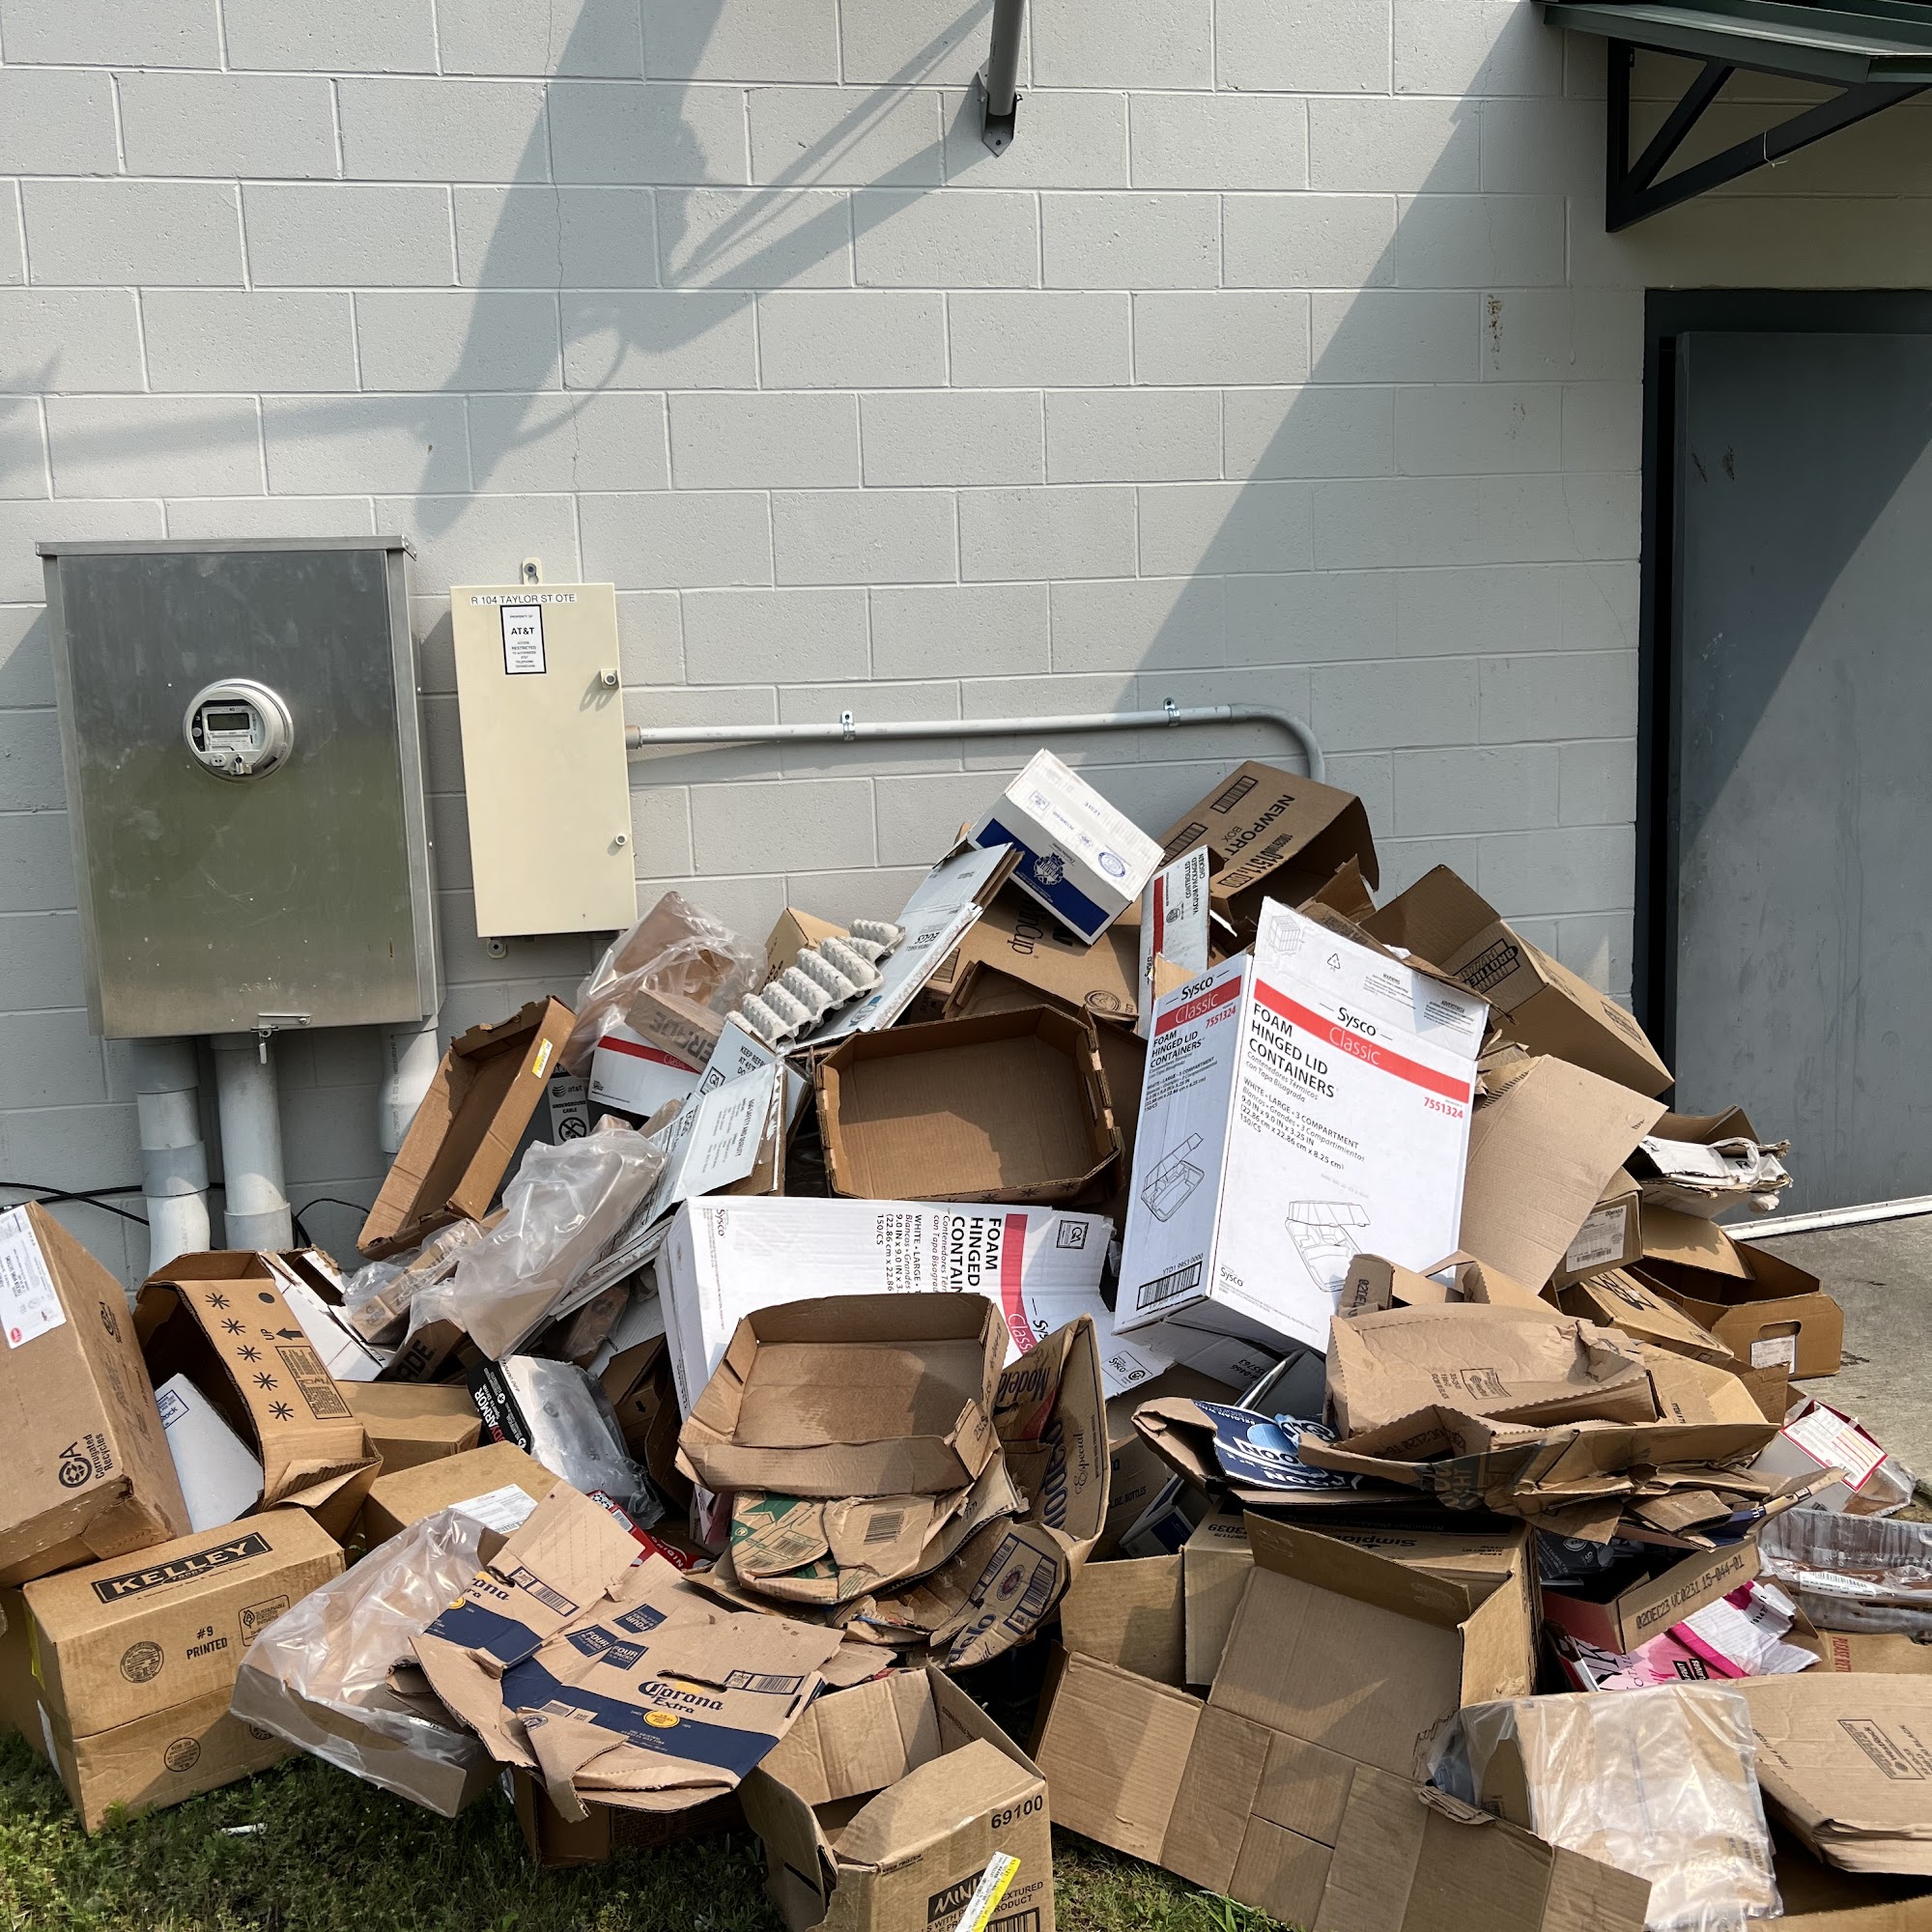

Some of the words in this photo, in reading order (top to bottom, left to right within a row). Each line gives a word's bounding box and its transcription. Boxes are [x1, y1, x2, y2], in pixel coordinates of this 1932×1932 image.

[500, 595, 538, 604] TAYLOR
[541, 595, 553, 603] ST
[555, 594, 575, 602] OTE
[1221, 825, 1242, 843] BOX
[1224, 796, 1295, 856] NEWPORT
[1181, 977, 1213, 1000] Sysco
[1175, 993, 1219, 1024] Classic
[1205, 1005, 1236, 1029] 7551324
[1254, 1002, 1293, 1037] FOAM
[1338, 1006, 1376, 1036] Sysco
[1152, 1037, 1183, 1058] HINGED
[1185, 1031, 1198, 1043] LID
[1153, 1030, 1177, 1047] FOAM
[1251, 1020, 1302, 1060] HINGED
[1306, 1053, 1328, 1075] LID
[1329, 1027, 1381, 1065] Classic
[1150, 1040, 1202, 1068] CONTAINERS
[1247, 1051, 1288, 1084] Contenedores
[1289, 1076, 1318, 1100] Térmicos
[1249, 1038, 1335, 1098] CONTAINERS
[567, 1084, 582, 1093] at&t
[1246, 1061, 1257, 1073] con
[1258, 1065, 1273, 1083] Tapa
[1274, 1075, 1306, 1103] Bisagrada
[1241, 1096, 1252, 1107] 9.0
[1252, 1101, 1260, 1111] IN
[1265, 1111, 1276, 1123] 9.0
[1276, 1118, 1284, 1128] IN
[1291, 1127, 1305, 1141] 3.25
[1307, 1135, 1314, 1146] IN
[1244, 1077, 1265, 1096] WHITE
[1269, 1094, 1291, 1112] LARGE
[1295, 1111, 1300, 1120] 3
[1301, 1114, 1359, 1149] COMPARTMENT
[1424, 1097, 1464, 1119] 7551324
[1240, 1114, 1262, 1133] 150/CS
[1243, 1087, 1265, 1107] Blancos
[1270, 1102, 1296, 1127] Grandes
[1301, 1123, 1305, 1132] 3
[1306, 1127, 1365, 1162] Compartimientos
[1260, 1119, 1271, 1130] cm
[1276, 1129, 1295, 1147] 22.86
[1296, 1143, 1307, 1153] cm
[1313, 1150, 1329, 1164] 8.25
[716, 1209, 724, 1236] Sysco
[896, 1229, 903, 1240] IN
[886, 1239, 892, 1257] cm
[967, 1217, 984, 1287] HINGED
[985, 1217, 1002, 1270] FOAM
[894, 1264, 902, 1275] IN
[1220, 1267, 1244, 1287] Sysco
[260, 1329, 274, 1341] UP
[1109, 1356, 1126, 1373] Sysco
[83, 1434, 105, 1479] Corrugated
[95, 1433, 114, 1471] Recycles
[1073, 1431, 1089, 1494] Especial
[110, 1540, 249, 1596] KELLEY
[1636, 1599, 1670, 1629] 02DEC23
[1671, 1581, 1701, 1608] VC0231
[1702, 1555, 1744, 1590] 15-044-01
[196, 1626, 215, 1640] #9
[625, 1616, 649, 1630] FOUR
[186, 1637, 228, 1660] PRINTED
[586, 1631, 610, 1647] FOUR
[612, 1646, 638, 1657] FOUR
[638, 1681, 723, 1711] Corona
[652, 1698, 694, 1714] Extra
[991, 1795, 1043, 1829] 69100
[1001, 1882, 1043, 1902] EXTURED
[934, 1913, 956, 1928] WITH
